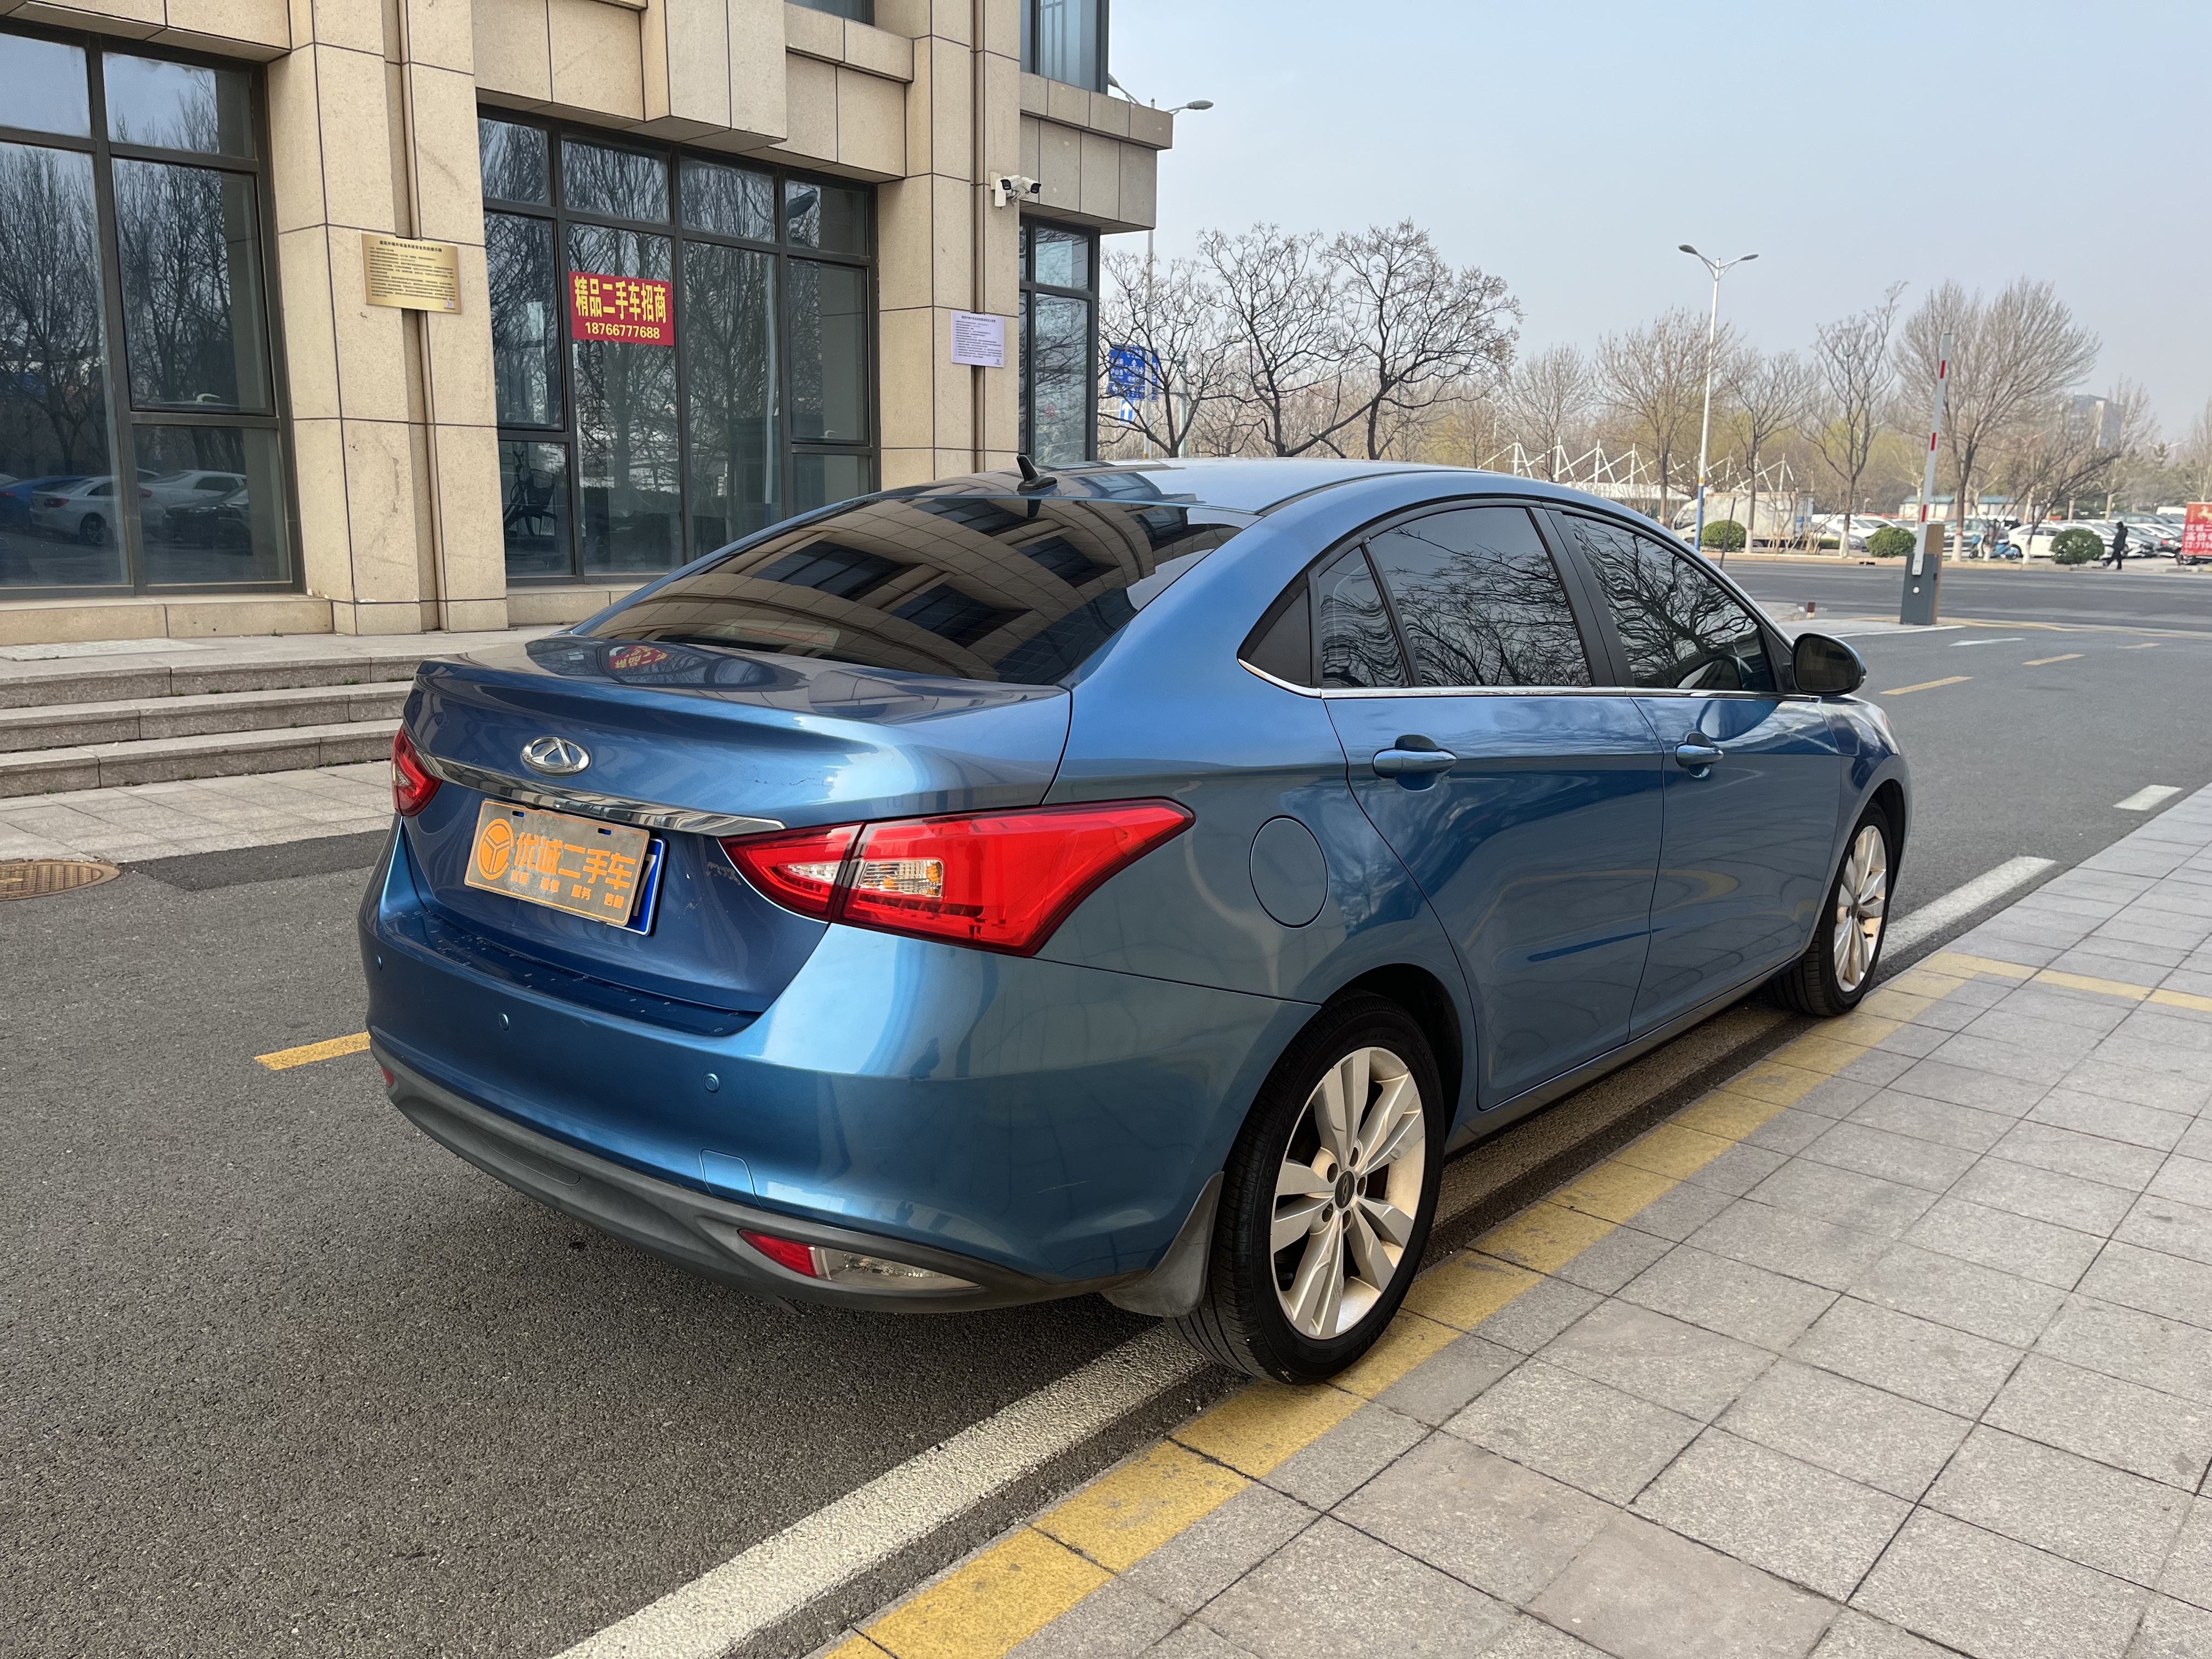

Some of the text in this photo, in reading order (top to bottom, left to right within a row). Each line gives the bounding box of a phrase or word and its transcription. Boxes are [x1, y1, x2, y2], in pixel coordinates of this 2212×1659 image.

[574, 275, 667, 324] 精品二手车招商
[585, 321, 661, 339] 18766777688
[514, 832, 636, 890] 优诚二手车
[571, 884, 592, 900] 服务
